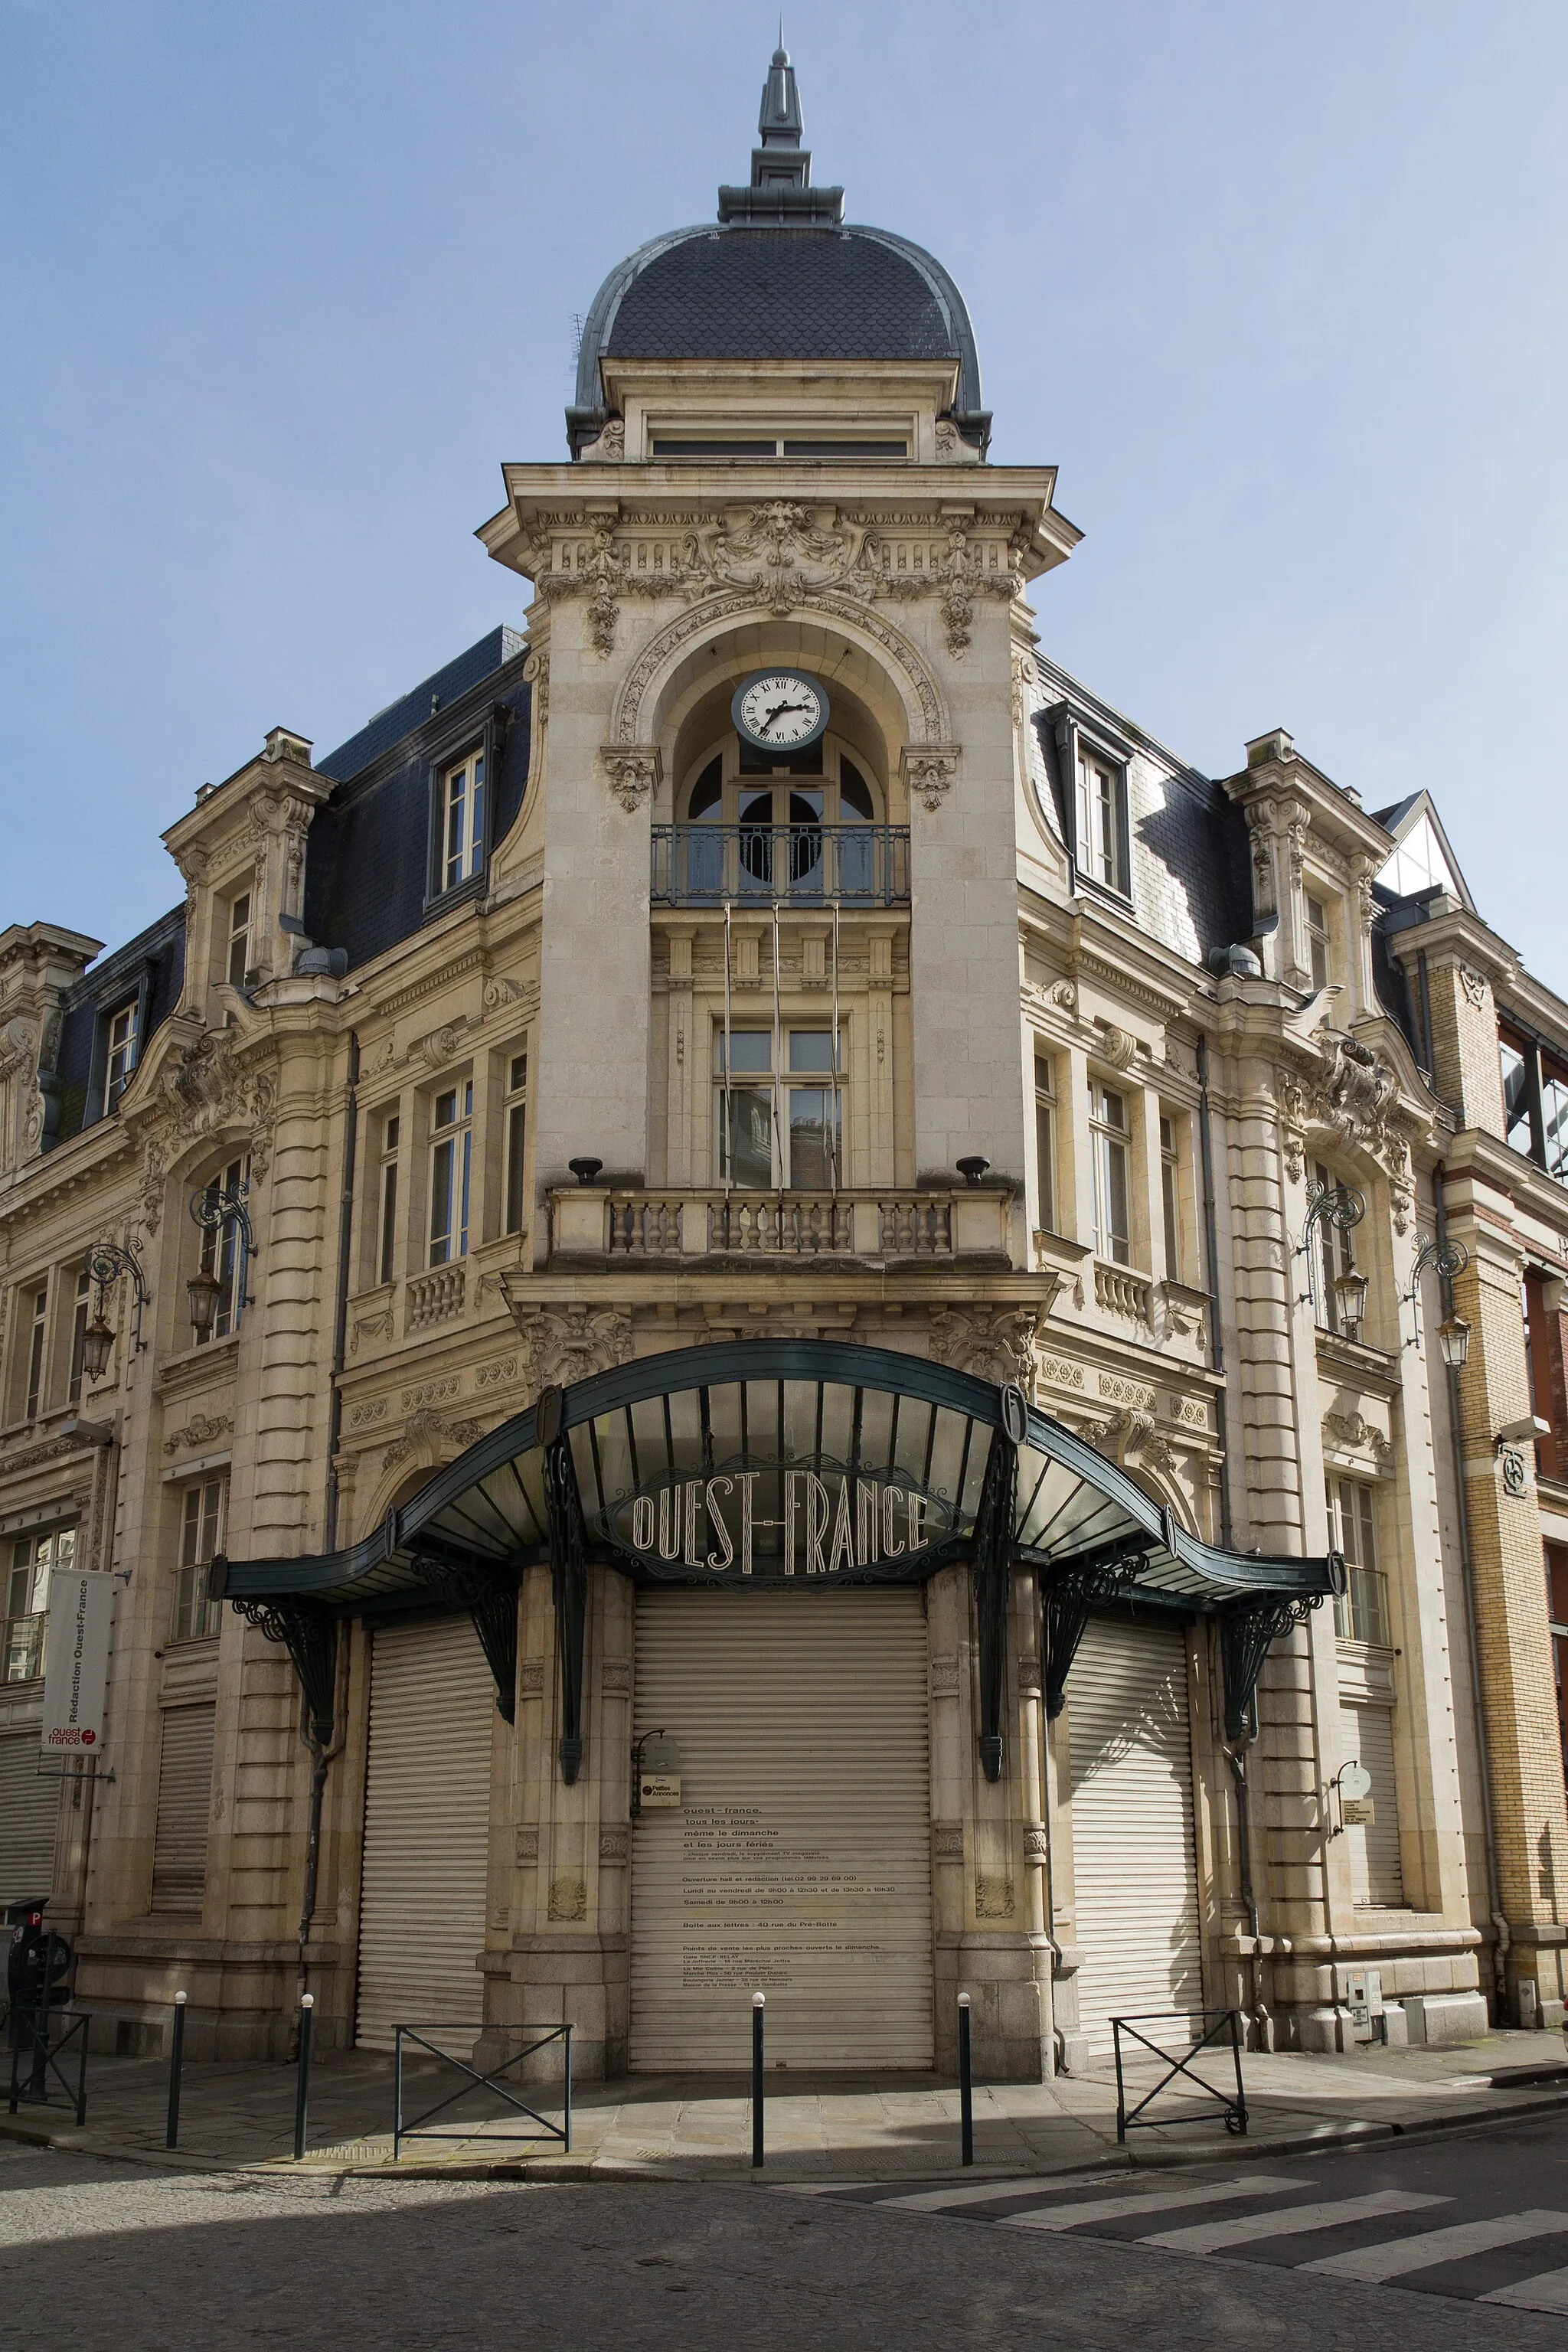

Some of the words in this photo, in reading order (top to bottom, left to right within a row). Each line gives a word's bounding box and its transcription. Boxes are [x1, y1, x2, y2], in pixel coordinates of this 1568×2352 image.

[760, 683, 771, 693] XI
[632, 1470, 929, 1576] OUEST-FRANCE
[74, 1579, 87, 1658] Ouest-France
[69, 1661, 81, 1723] Rédaction
[52, 1727, 80, 1738] ouest
[48, 1733, 80, 1745] france
[32, 1913, 41, 1925] P
